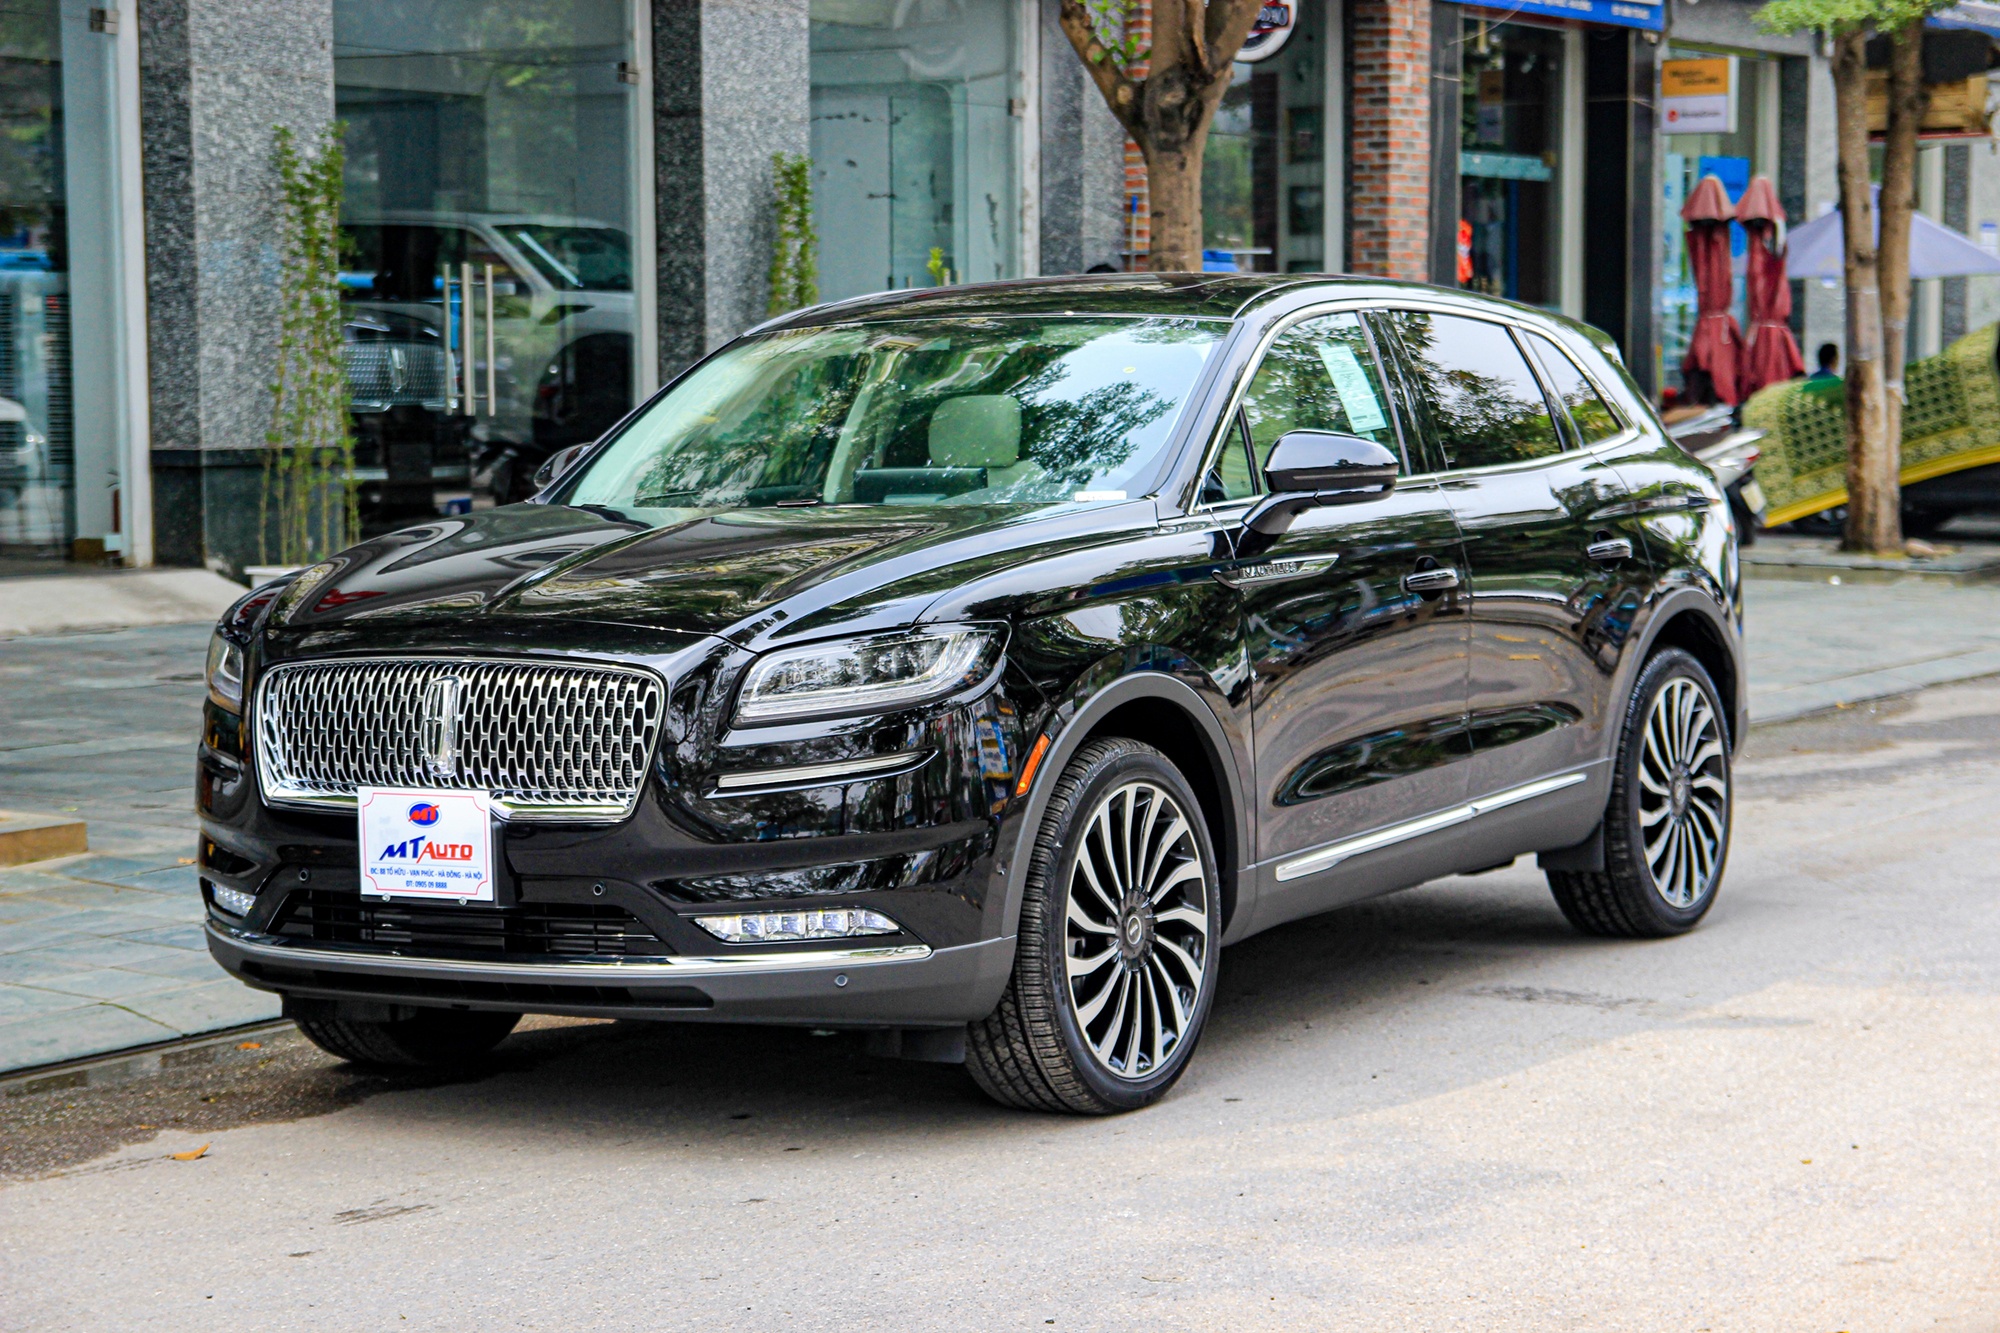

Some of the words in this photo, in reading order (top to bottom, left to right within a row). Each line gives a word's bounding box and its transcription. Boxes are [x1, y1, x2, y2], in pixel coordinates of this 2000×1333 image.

[1242, 561, 1298, 578] NAUTILUS
[408, 804, 440, 822] MT
[438, 869, 446, 878] HÀ
[464, 870, 473, 879] HÀ
